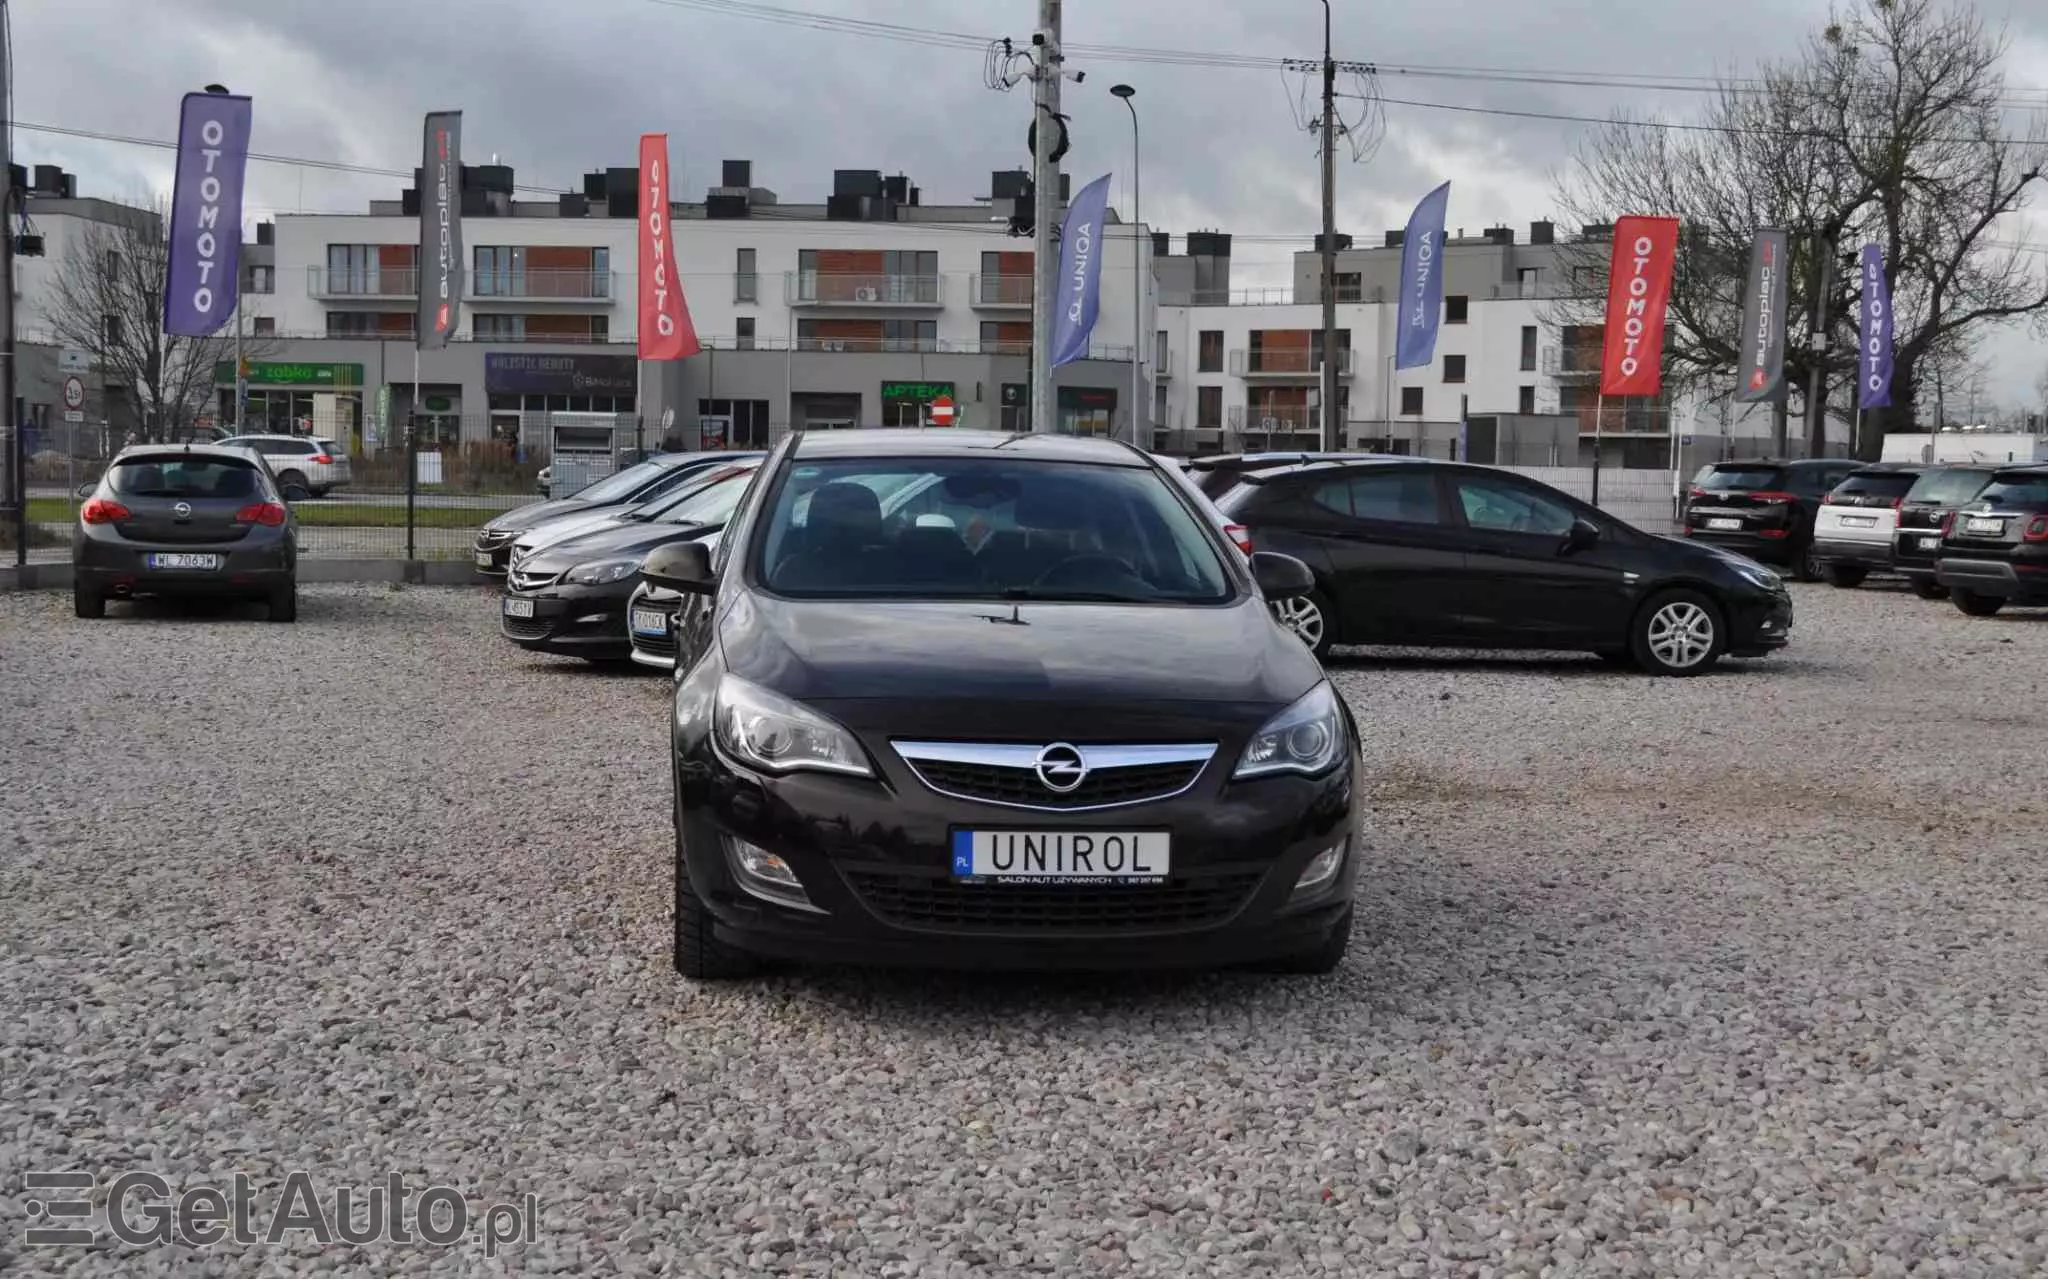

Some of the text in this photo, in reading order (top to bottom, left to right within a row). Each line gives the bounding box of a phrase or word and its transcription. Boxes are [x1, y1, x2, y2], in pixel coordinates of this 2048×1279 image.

[193, 119, 224, 313] OTOMOTO
[649, 159, 674, 336] OTOMOTO
[1072, 221, 1092, 291] UNIQA
[1620, 236, 1653, 377] OTOMOTO
[1868, 263, 1883, 392] OTOMOTO
[883, 385, 953, 397] APTEKA
[956, 856, 969, 868] PL
[992, 834, 1152, 872] UNIROL
[997, 875, 1030, 885] SALON
[1031, 875, 1051, 885] AUT
